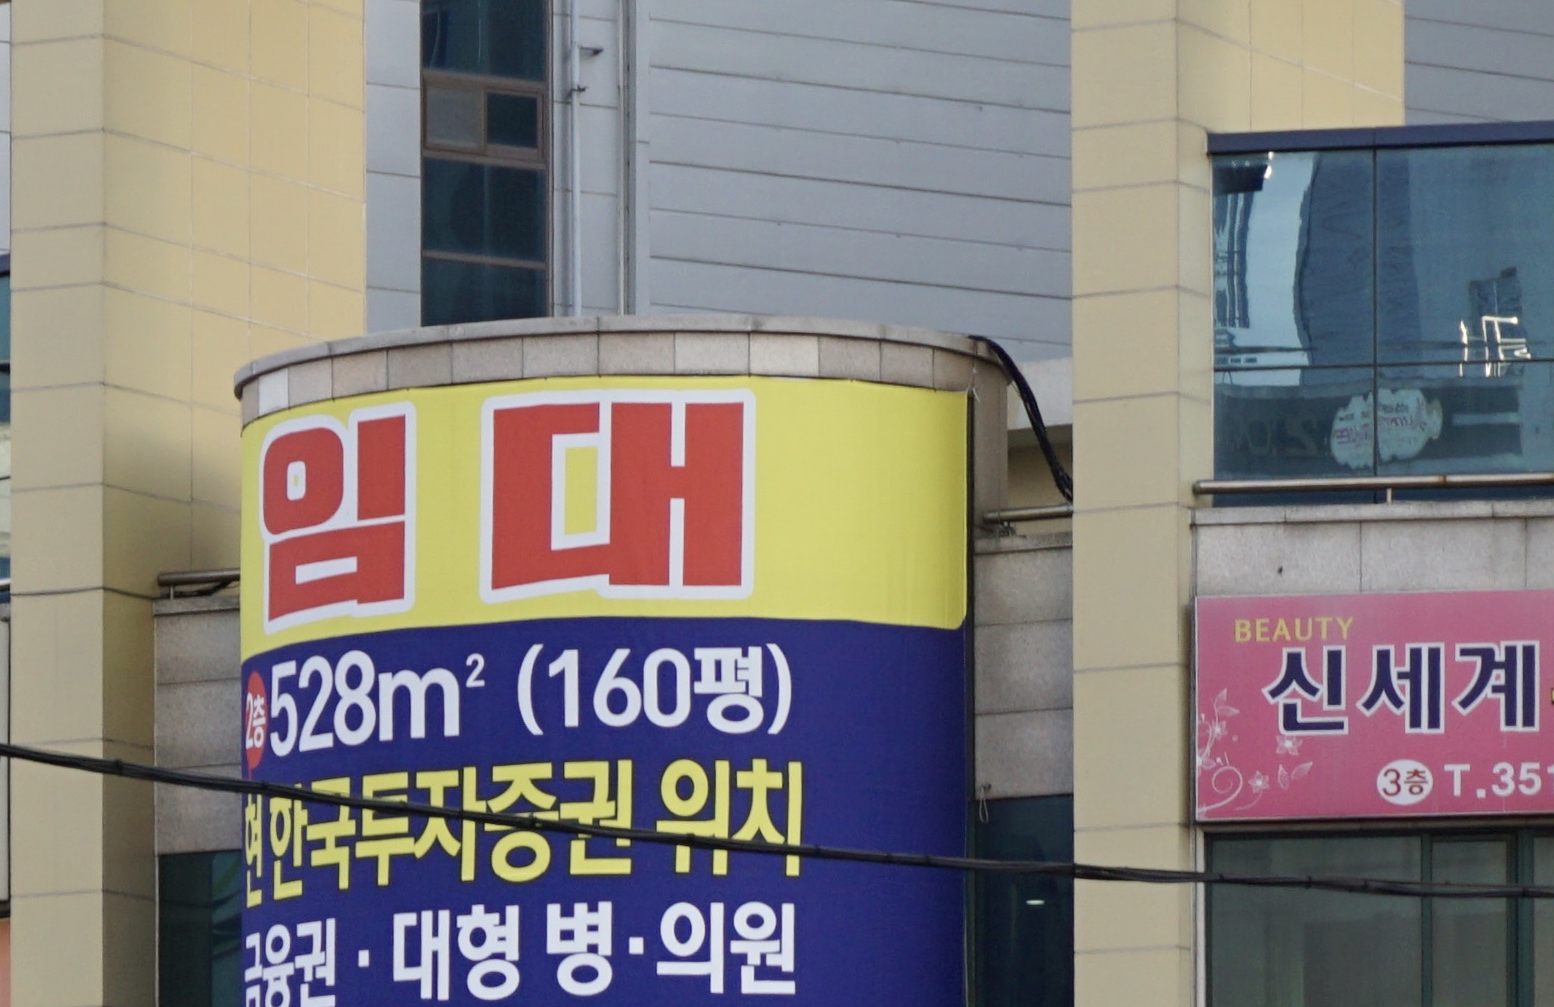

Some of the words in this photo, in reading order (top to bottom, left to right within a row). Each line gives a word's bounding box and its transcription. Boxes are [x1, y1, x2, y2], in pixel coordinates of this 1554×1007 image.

[1234, 616, 1355, 644] BEAUTY
[517, 643, 793, 736] (160평)
[1261, 640, 1542, 737] 신세계
[269, 758, 633, 900] 한국투자증권
[656, 758, 803, 877] 위치
[1381, 766, 1431, 798] 3층
[393, 904, 520, 1001] 대형
